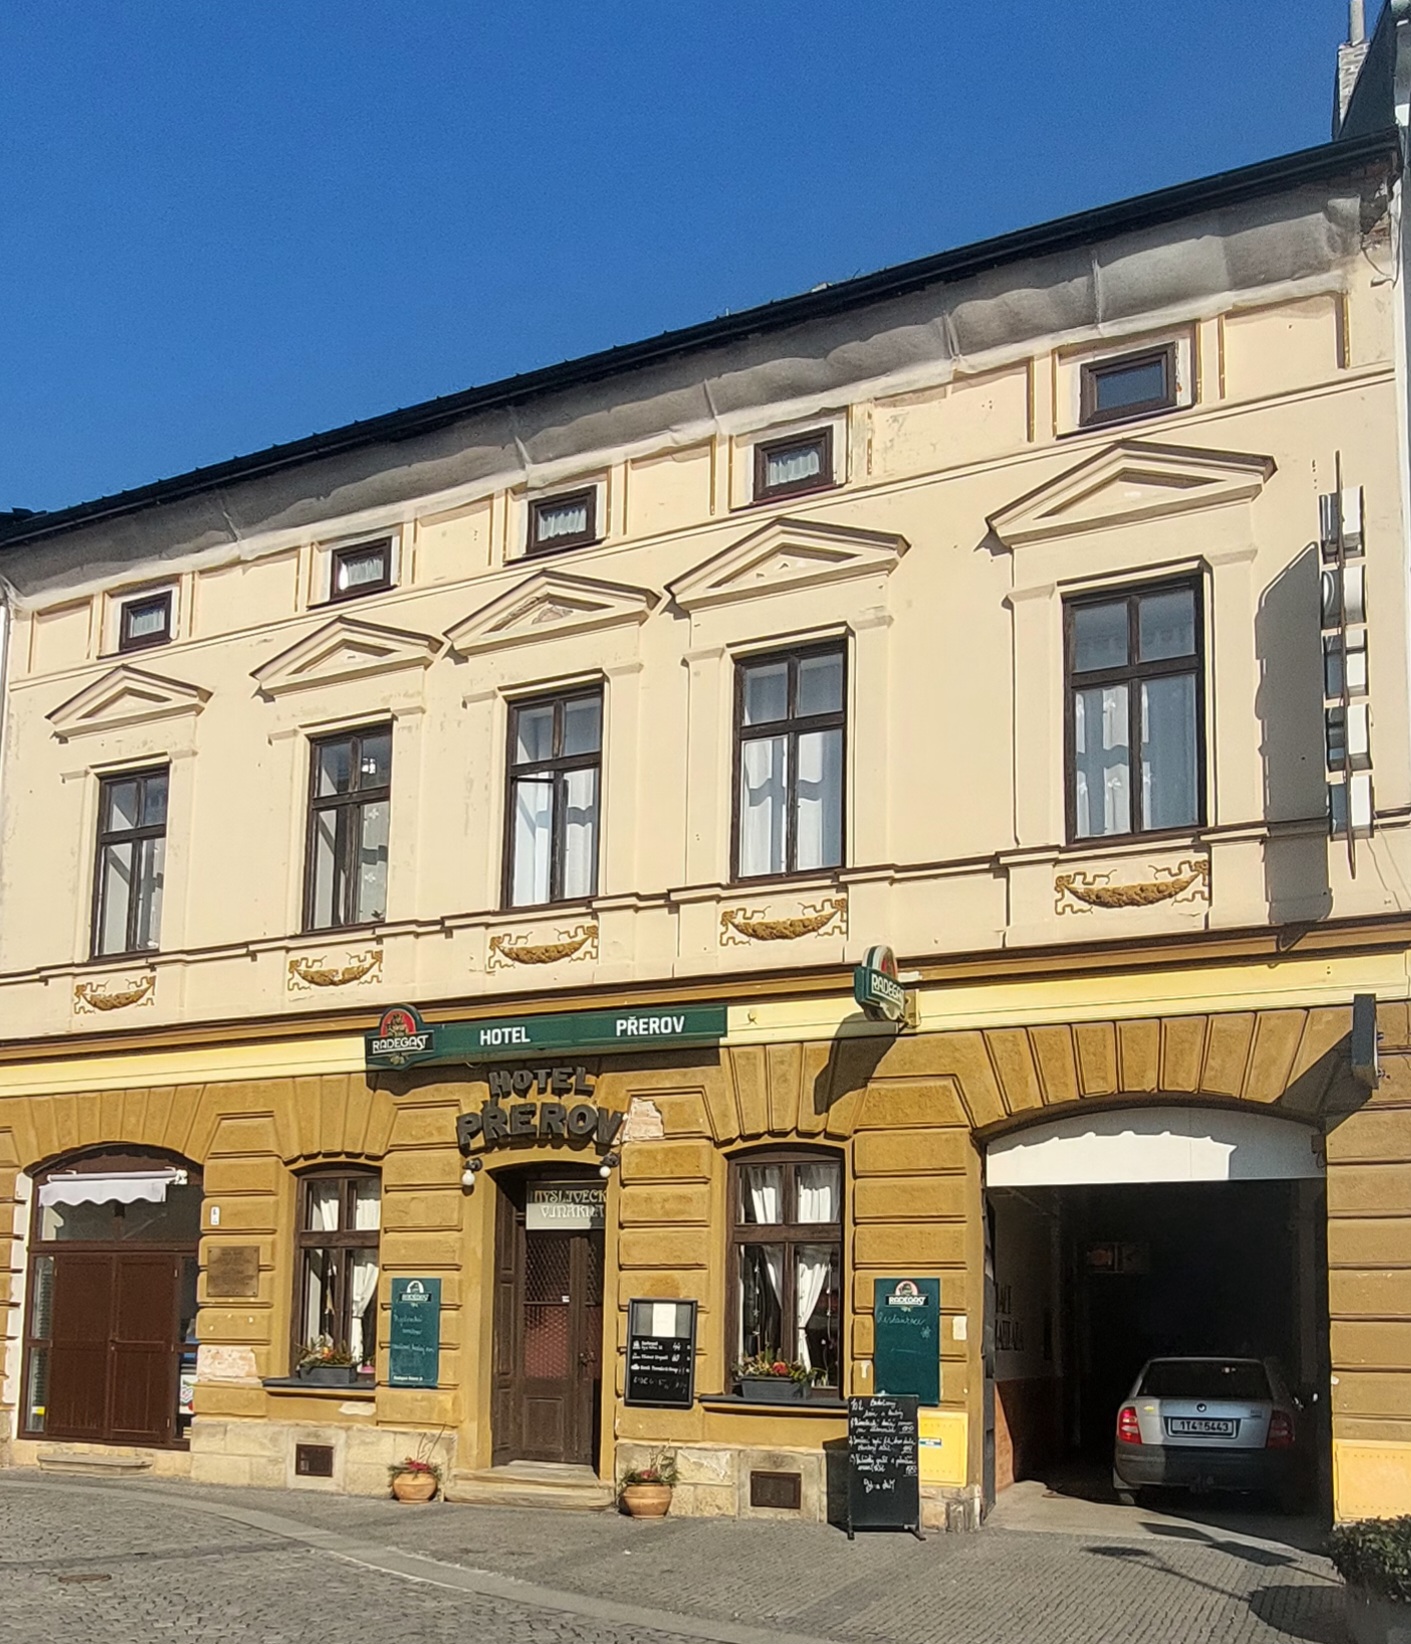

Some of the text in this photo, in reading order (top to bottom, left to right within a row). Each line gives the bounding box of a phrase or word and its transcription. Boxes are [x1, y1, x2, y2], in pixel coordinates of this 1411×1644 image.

[480, 1015, 685, 1046] HOTEL PŘEROV
[372, 1035, 429, 1054] RADEGAST
[488, 1066, 595, 1098] HOTEL
[456, 1098, 624, 1154] PŘEROV
[530, 1189, 607, 1203] MYSLIVECK
[1180, 1420, 1229, 1432] 1T4 5443
